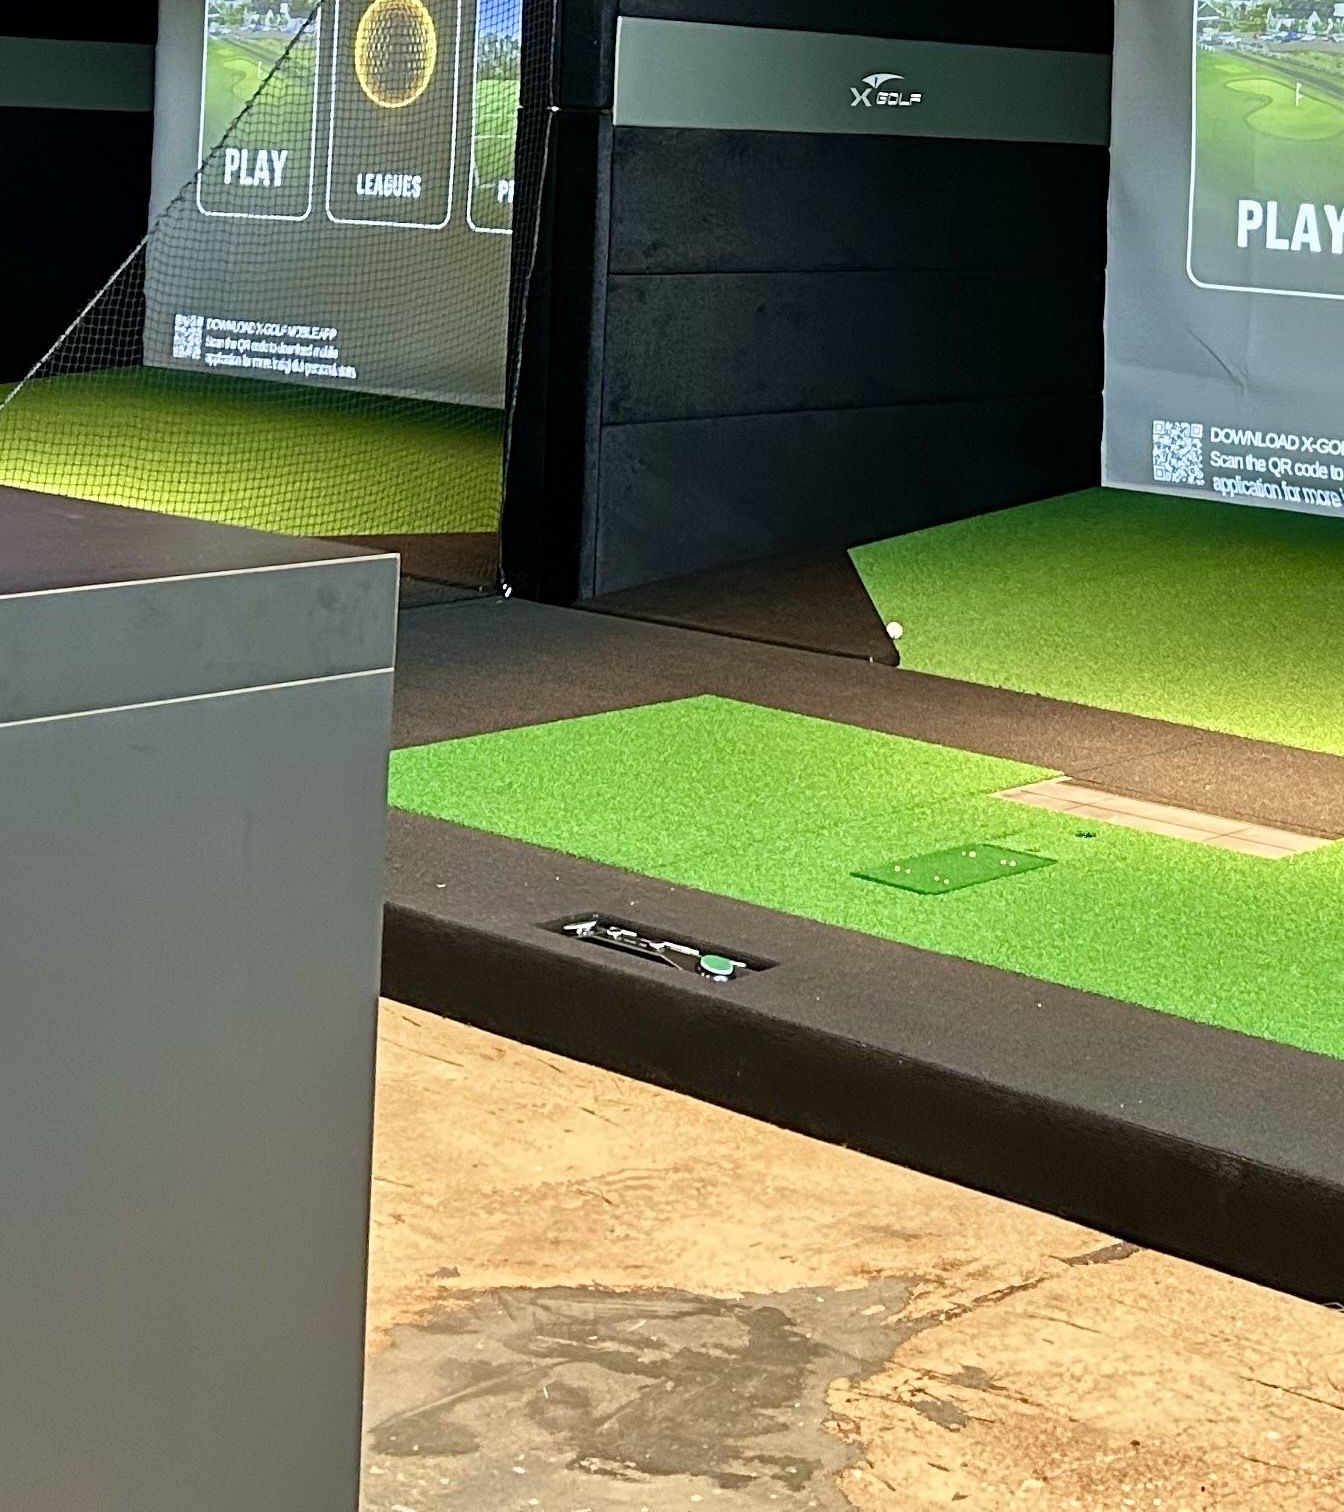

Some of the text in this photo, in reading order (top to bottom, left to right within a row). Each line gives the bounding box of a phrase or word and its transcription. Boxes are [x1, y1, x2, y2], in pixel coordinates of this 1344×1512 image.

[850, 87, 922, 107] X GOLF
[223, 147, 288, 187] PLAY
[356, 173, 422, 198] LEAGUES
[1210, 426, 1299, 451] DOWNLOAD
[1210, 450, 1245, 471] Scan
[1246, 454, 1267, 473] the
[1268, 457, 1294, 477] QR
[1294, 460, 1328, 479] code
[1330, 464, 1344, 481] to
[1212, 474, 1281, 500] application
[1282, 483, 1302, 503] for
[1304, 486, 1342, 508] more
